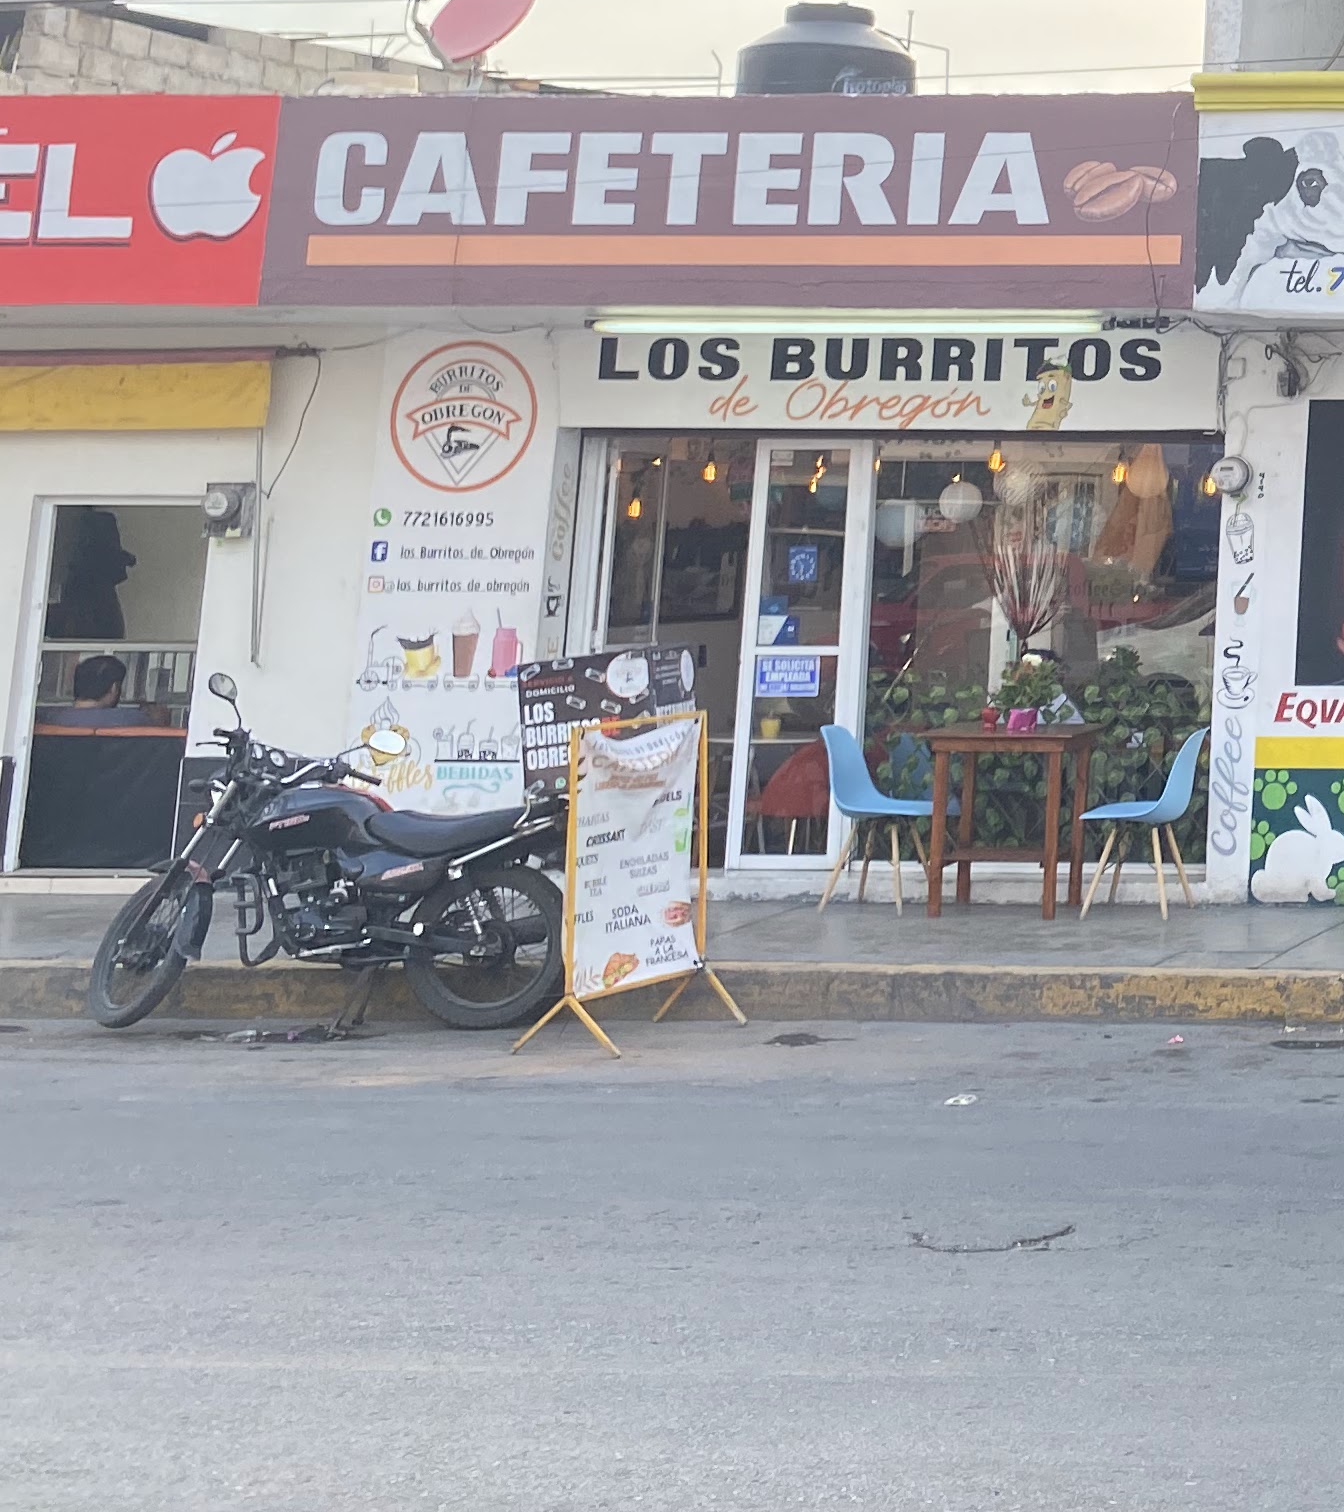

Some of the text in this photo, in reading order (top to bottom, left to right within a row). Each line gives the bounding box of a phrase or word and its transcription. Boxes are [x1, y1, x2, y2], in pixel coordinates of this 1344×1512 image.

[313, 130, 1051, 227] CAFETERIA
[1279, 259, 1322, 293] tel.
[599, 337, 1163, 382] LOS BURRITOS
[429, 364, 504, 395] BURRITOS
[709, 374, 990, 430] de Obregón
[421, 403, 506, 426] OBREGON
[402, 510, 495, 527] 7721616995
[524, 701, 554, 725] LOS
[437, 764, 514, 781] BEBIDAS
[605, 912, 651, 934] ITALIANA
[611, 903, 639, 920] SODA
